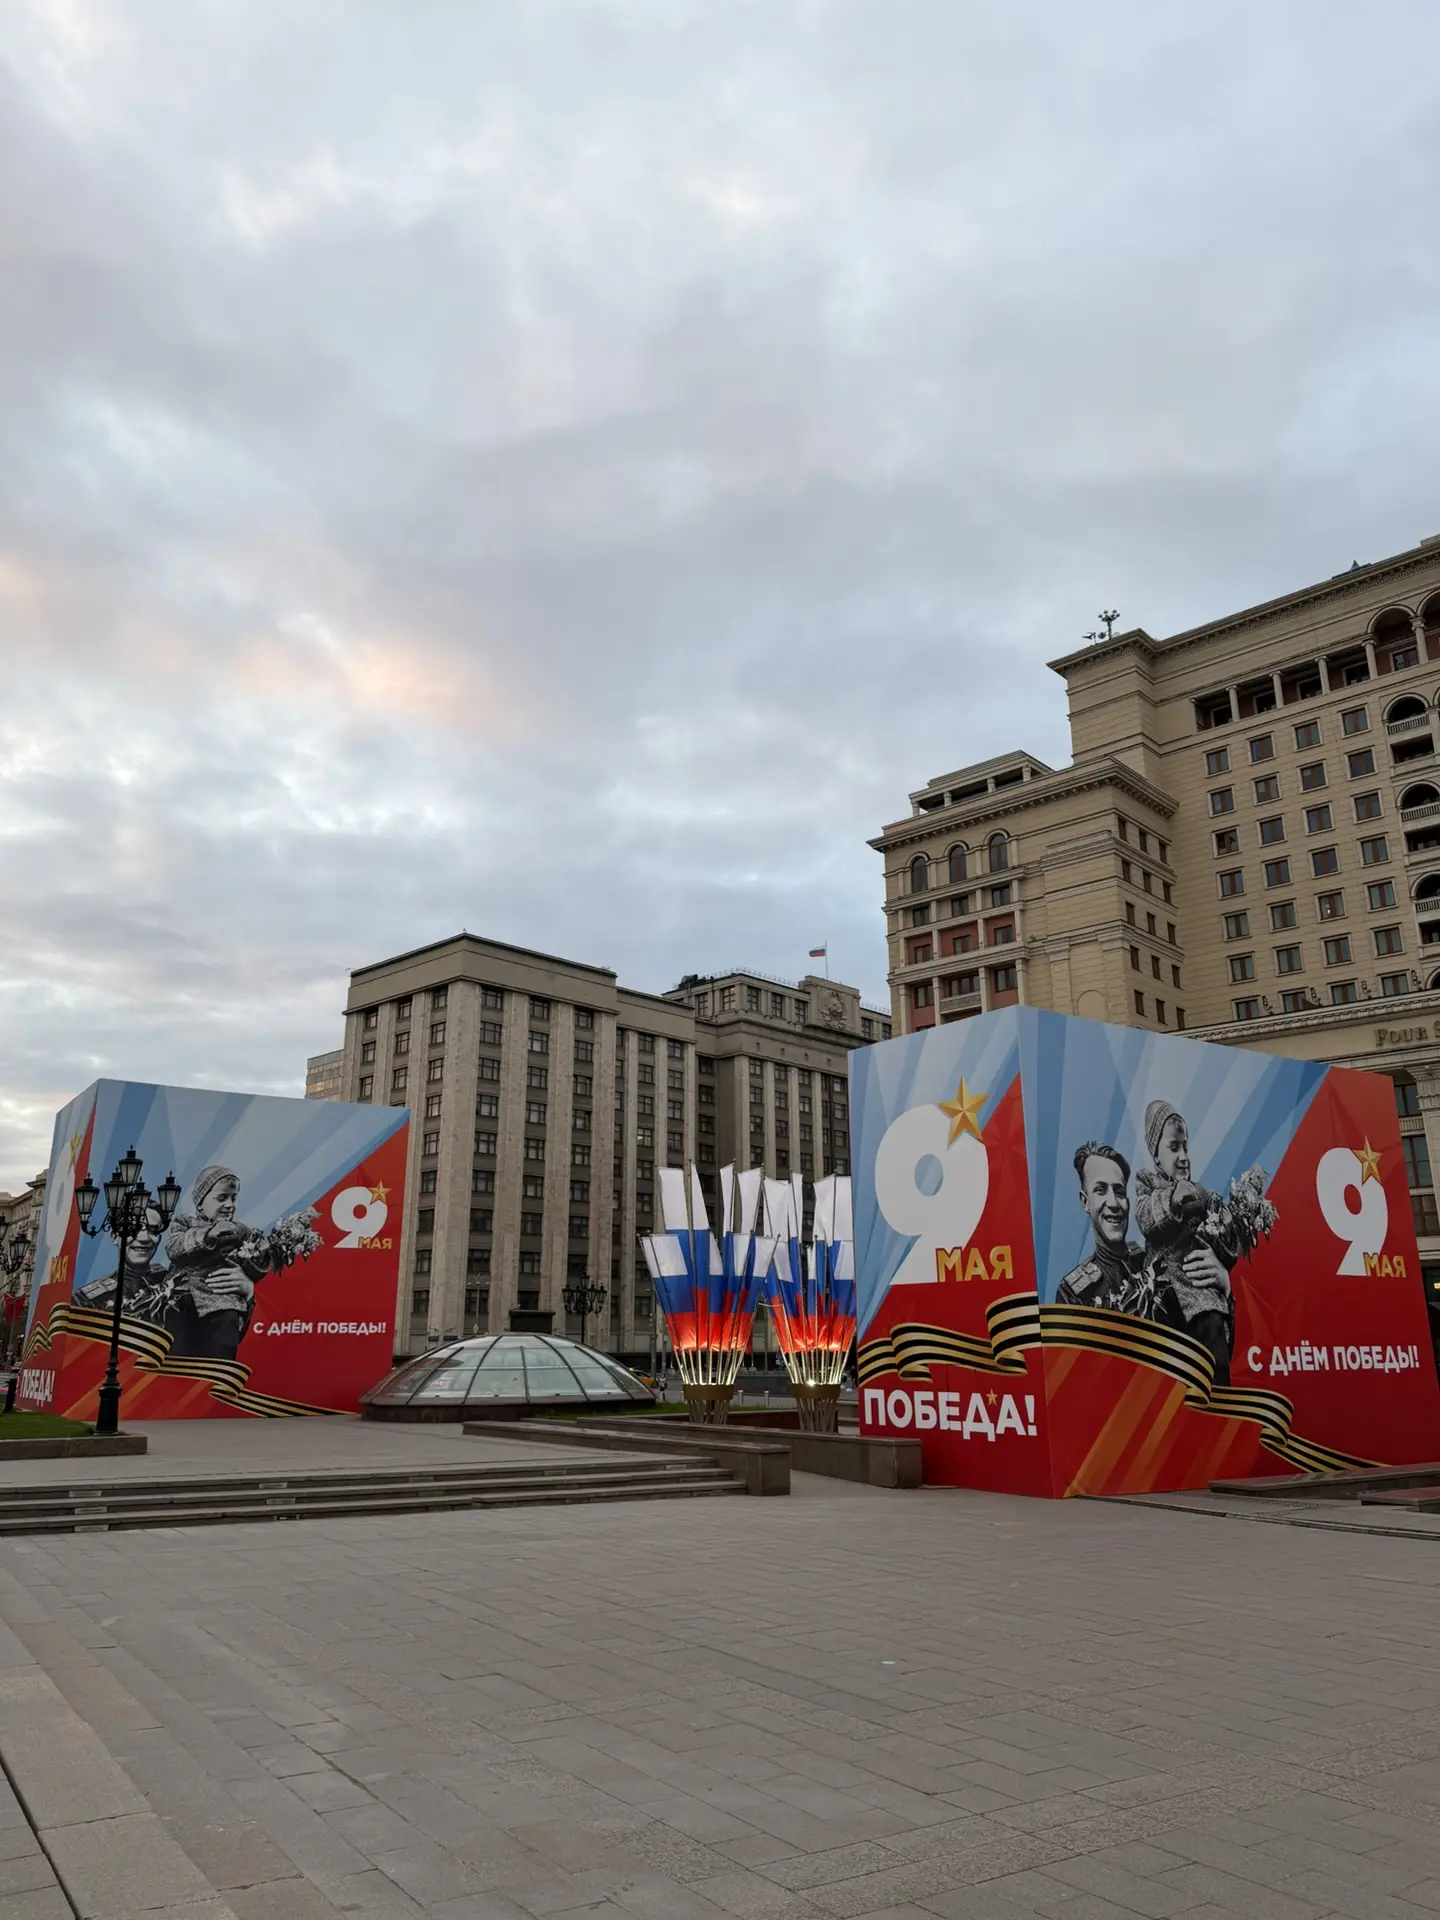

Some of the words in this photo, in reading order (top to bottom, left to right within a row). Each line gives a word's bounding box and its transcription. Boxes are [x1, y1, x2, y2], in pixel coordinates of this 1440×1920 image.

[1373, 1026, 1428, 1047] FOUR
[875, 1103, 989, 1285] 9
[1316, 1147, 1388, 1276] 9
[331, 1186, 388, 1248] 9
[358, 1237, 393, 1250] МАЯ
[935, 1244, 1014, 1282] МАЯ
[1363, 1252, 1407, 1278] МАЯ
[253, 1322, 264, 1334] С
[267, 1319, 313, 1336] ДНЁМ
[317, 1322, 387, 1336] ПОБЕДЫ!
[1247, 1345, 1264, 1372] С
[1269, 1340, 1329, 1376] ДНЁМ
[1333, 1344, 1420, 1374] ПОБЕДЫ!
[863, 1388, 1038, 1442] ПОБЕДА!
